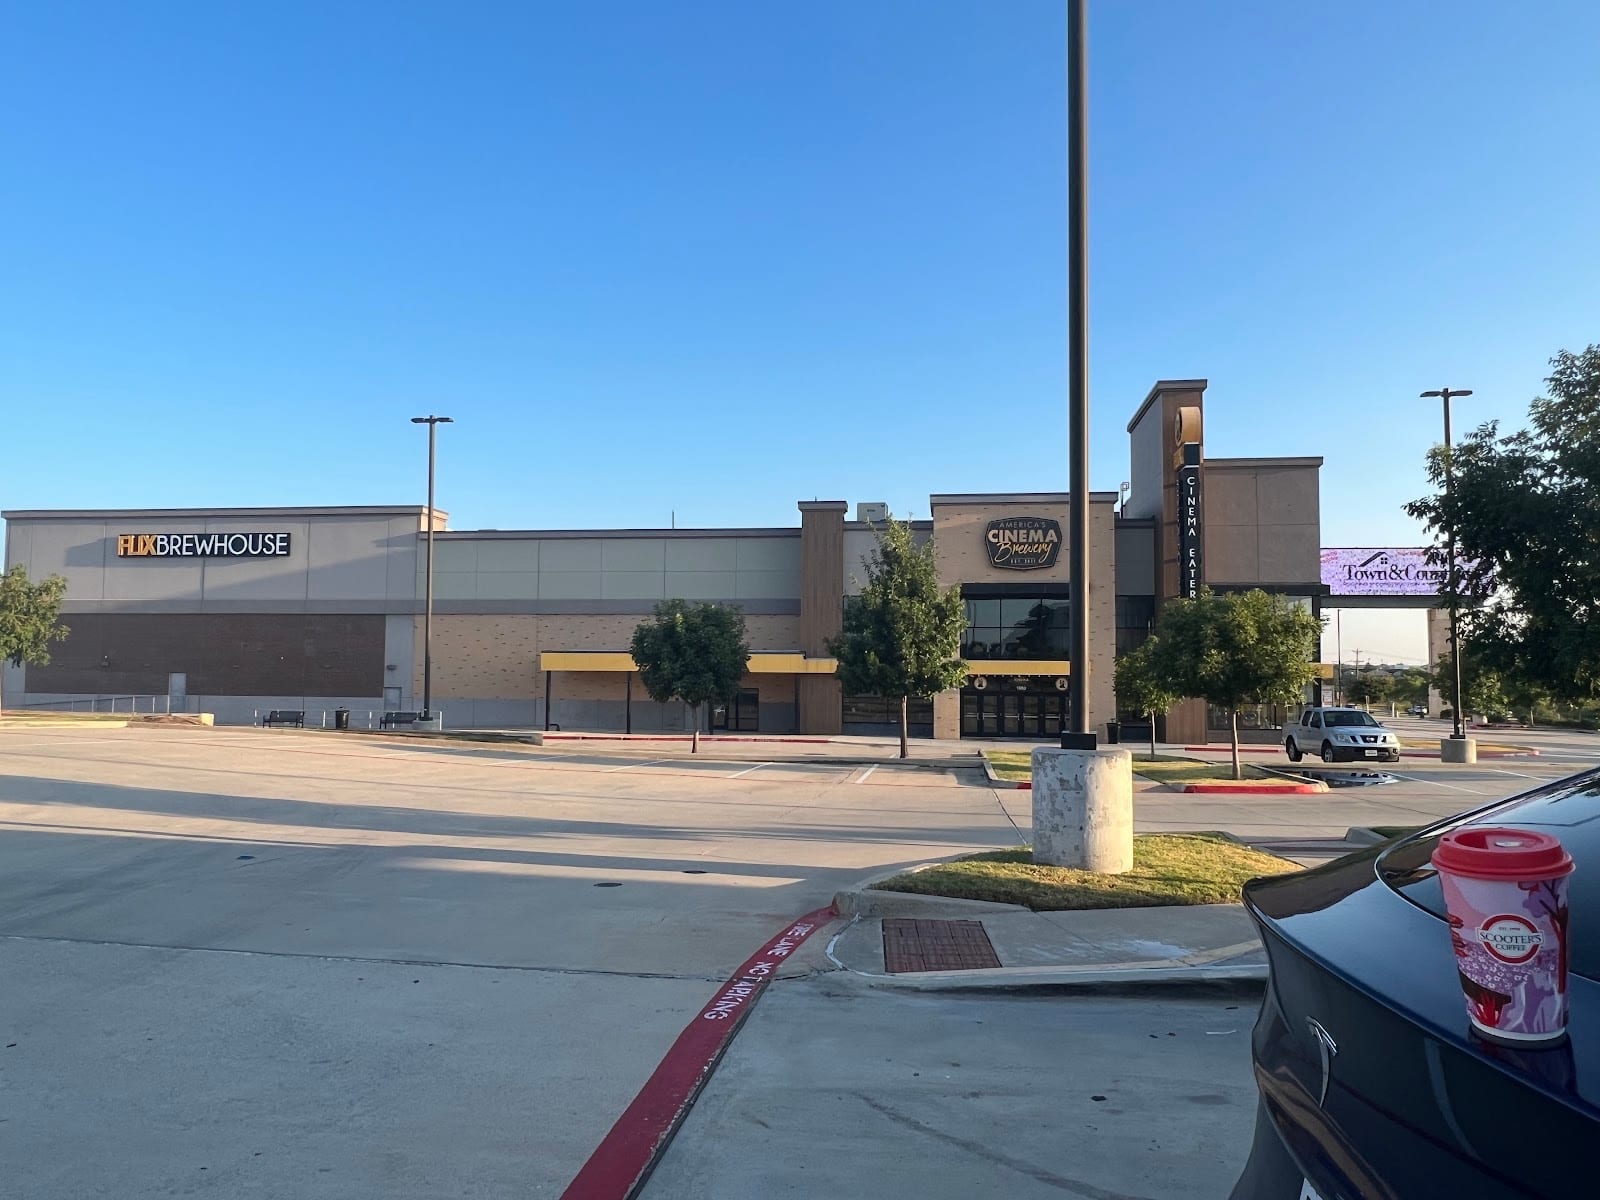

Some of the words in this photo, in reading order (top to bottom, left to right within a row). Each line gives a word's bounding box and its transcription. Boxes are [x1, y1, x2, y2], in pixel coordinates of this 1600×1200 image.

[1187, 476, 1197, 536] CINEMA
[988, 529, 1058, 542] CINEMA
[995, 541, 1053, 563] Brewery
[1189, 548, 1197, 599] EATER
[1495, 943, 1527, 951] COFFEE
